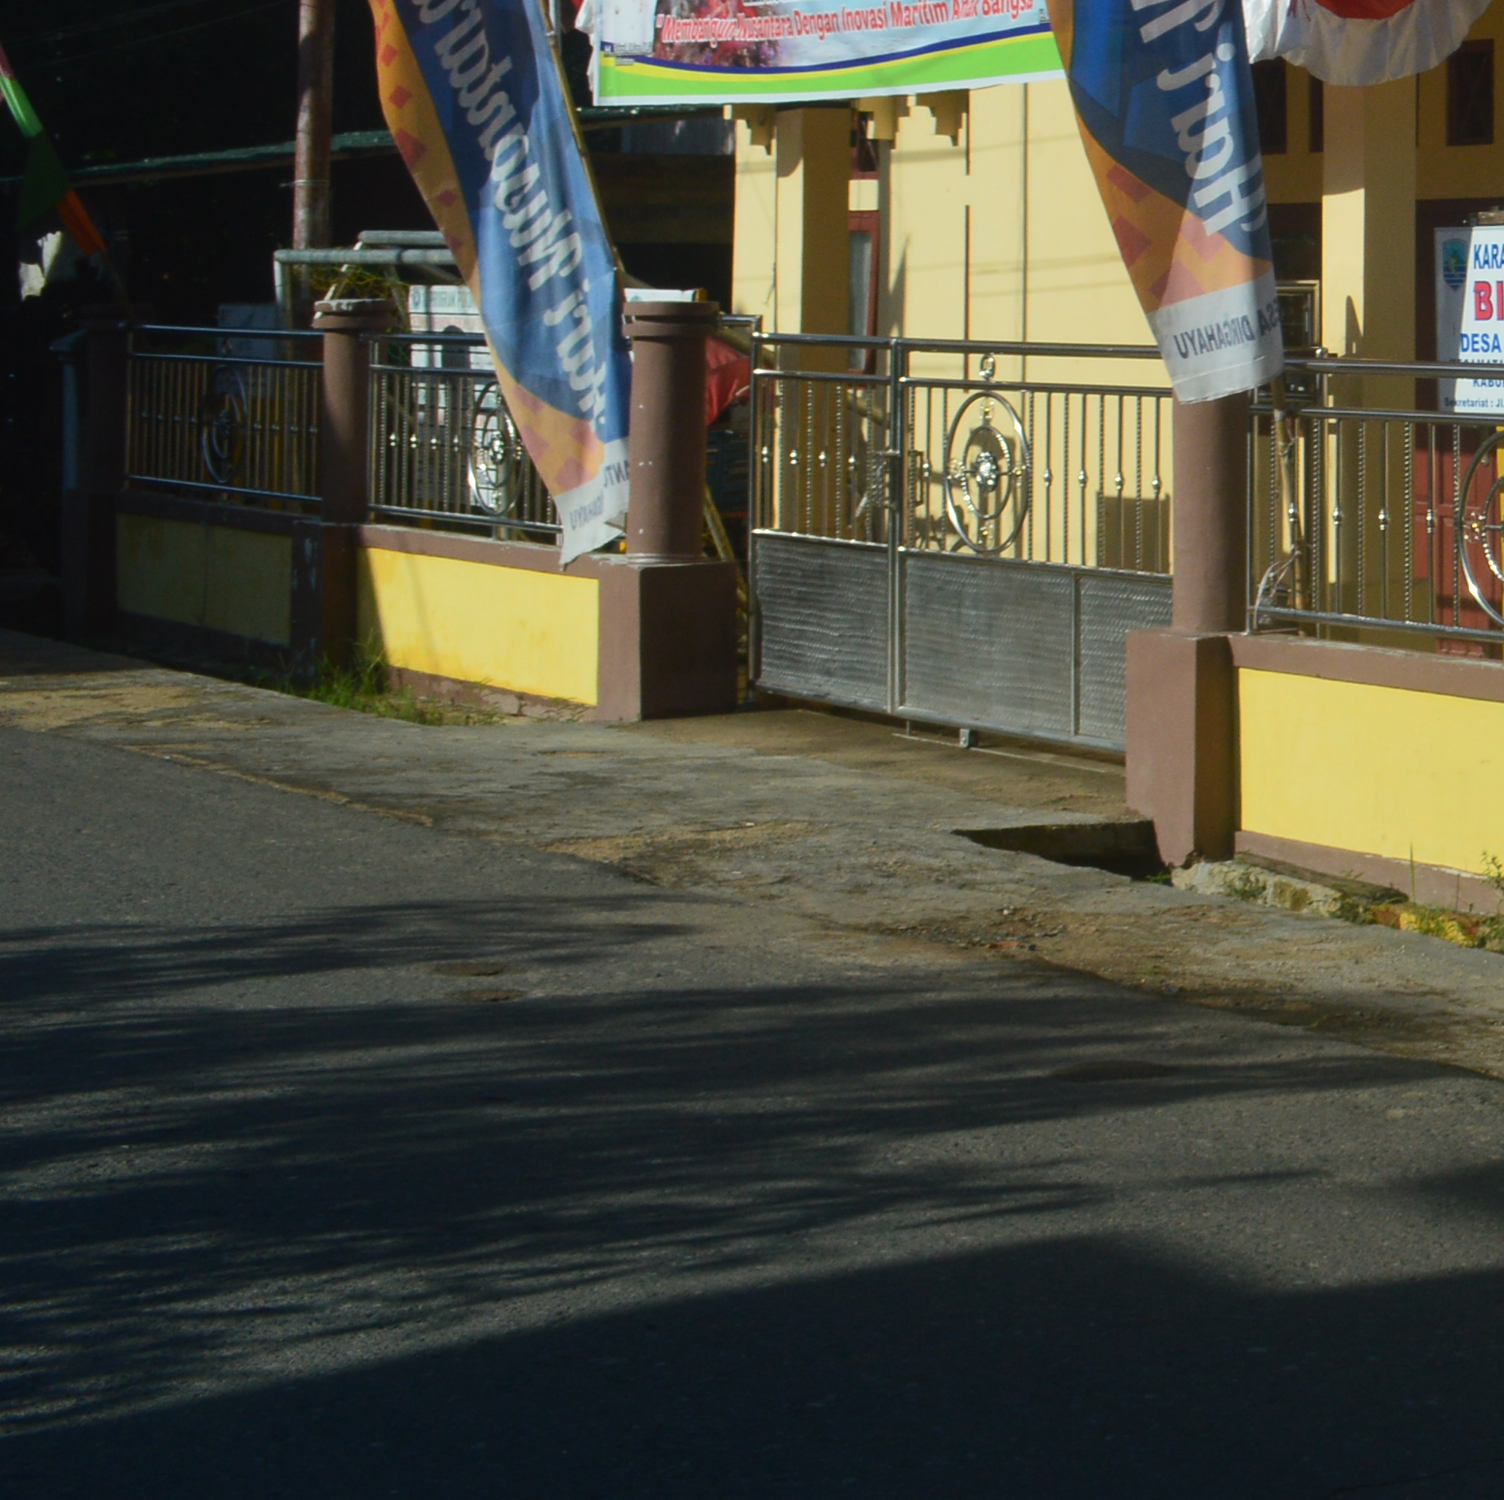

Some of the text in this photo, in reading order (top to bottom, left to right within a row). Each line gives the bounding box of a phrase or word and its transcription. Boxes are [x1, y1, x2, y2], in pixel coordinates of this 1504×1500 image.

[737, 13, 793, 41] Nusantara
[793, 9, 839, 40] Dengan
[841, 1, 888, 31] Inovasi
[1460, 333, 1502, 353] DESA
